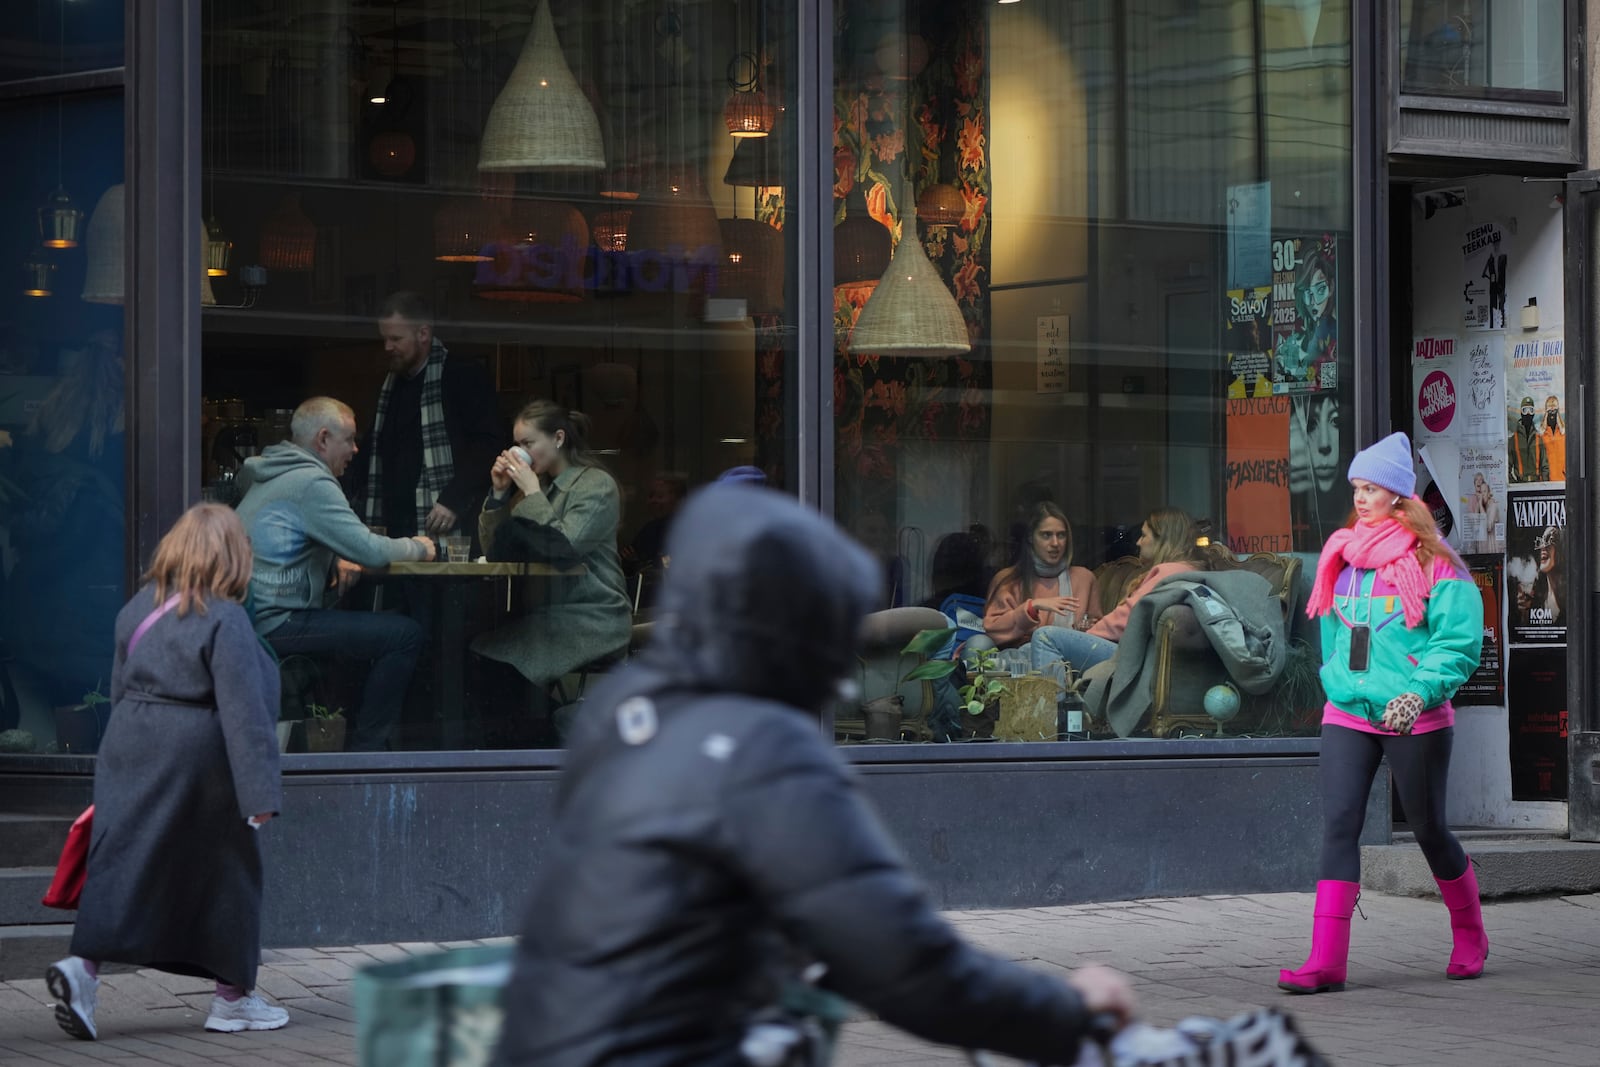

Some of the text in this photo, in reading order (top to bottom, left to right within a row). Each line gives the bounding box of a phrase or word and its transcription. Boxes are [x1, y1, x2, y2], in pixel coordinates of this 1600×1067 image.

[1466, 223, 1494, 242] TEEMU
[1273, 283, 1295, 301] INK
[1231, 296, 1268, 318] Savoy
[1273, 307, 1296, 324] 2025
[1513, 340, 1540, 359] HYVÄÄ
[1512, 500, 1567, 530] VAMPIRA
[1282, 535, 1290, 552] 7
[1530, 608, 1552, 619] KOM
